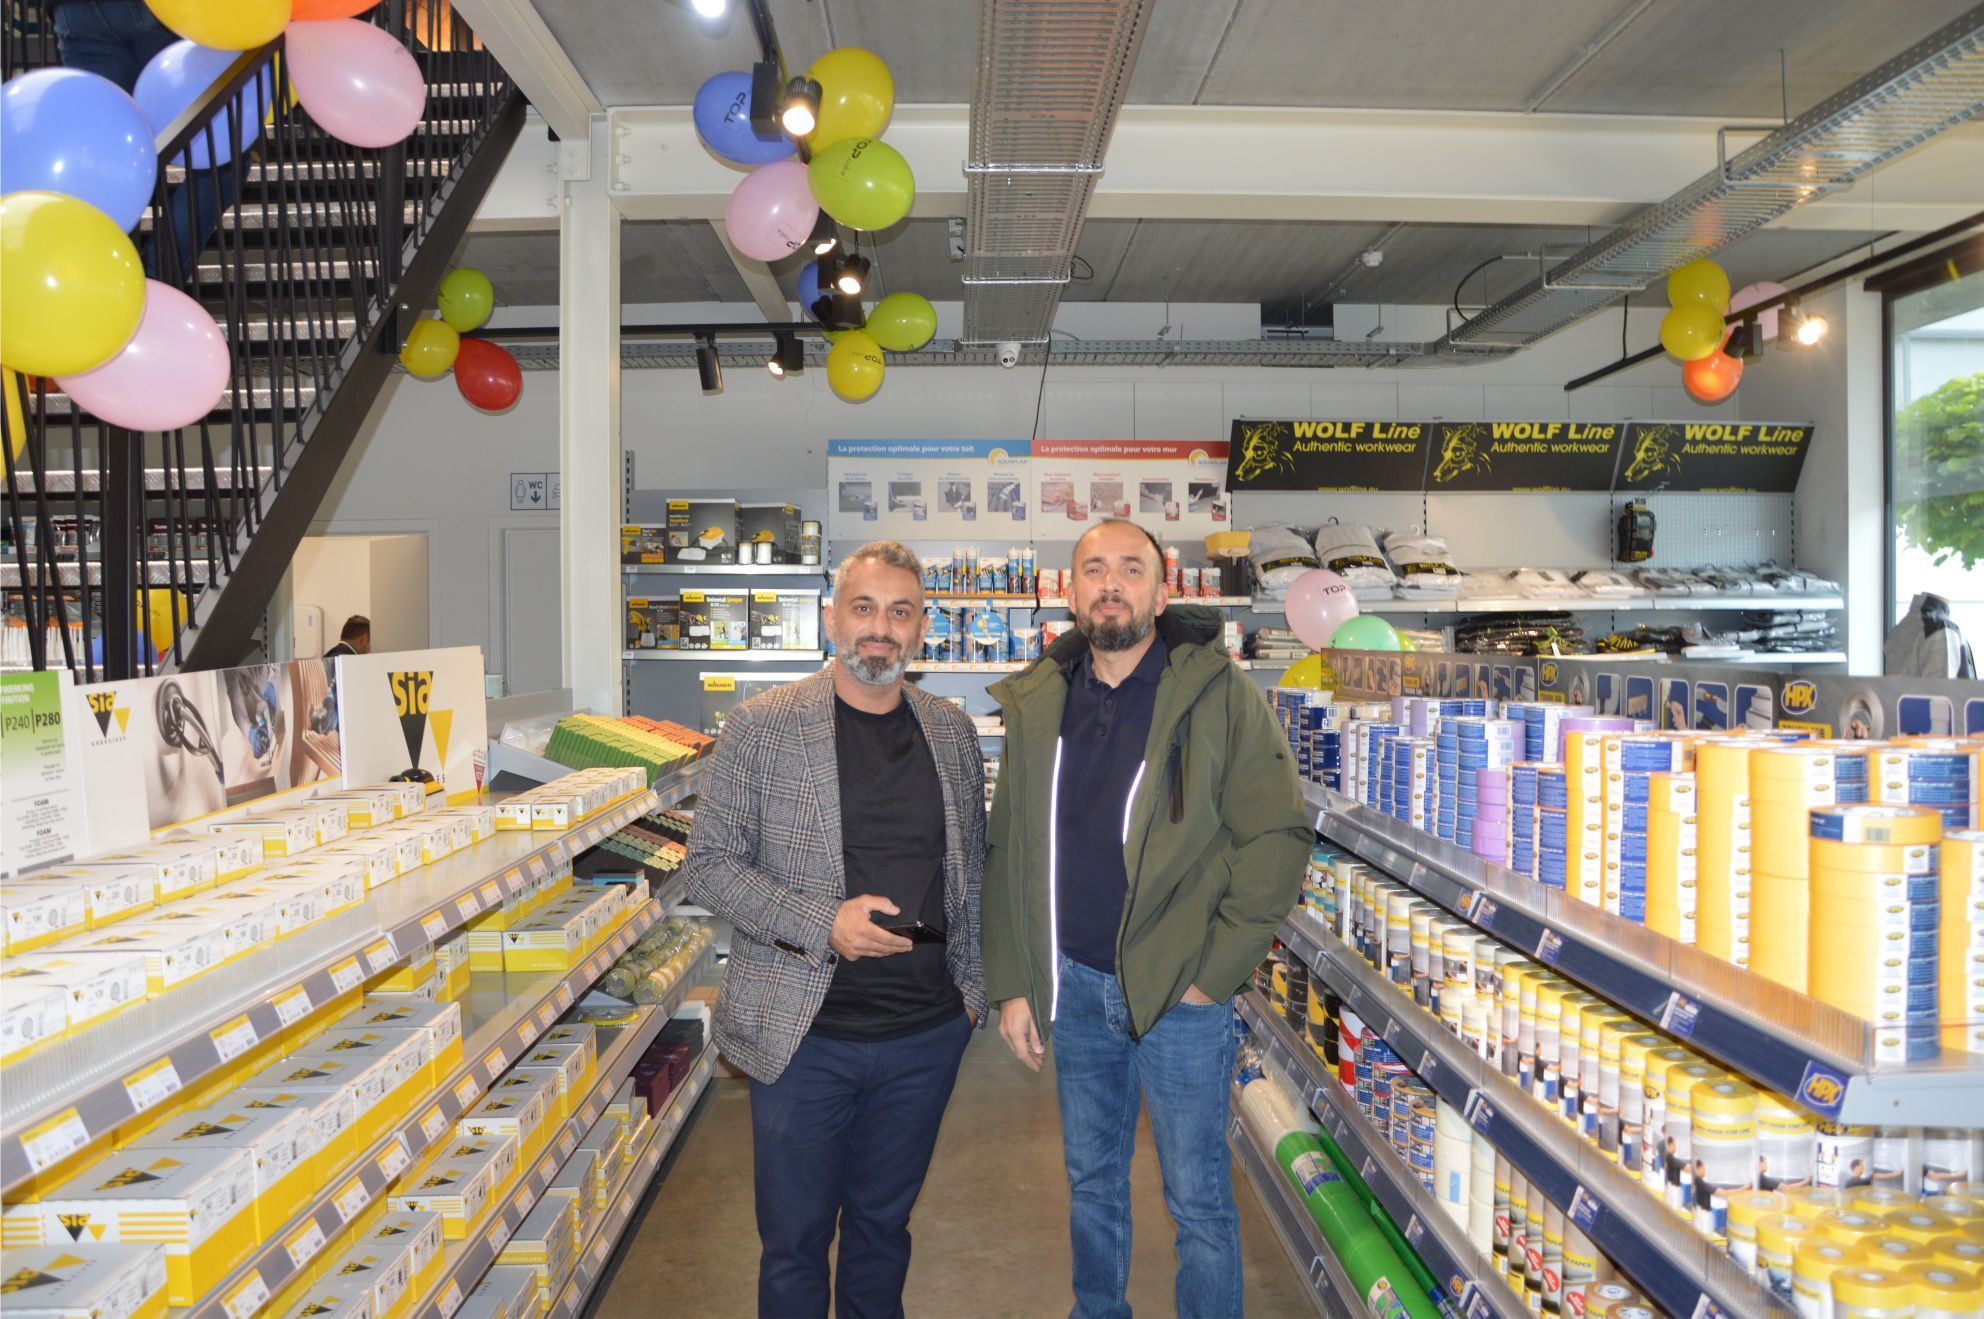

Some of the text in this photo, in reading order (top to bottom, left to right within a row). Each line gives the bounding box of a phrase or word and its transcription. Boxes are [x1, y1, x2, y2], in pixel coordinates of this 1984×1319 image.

[723, 91, 747, 125] TOP
[1292, 421, 1421, 440] WOLF Line
[1491, 422, 1615, 440] WOLF Line
[1684, 424, 1805, 443] WOLF Line
[848, 445, 887, 454] protection
[888, 445, 920, 454] optimale
[962, 444, 974, 452] toit
[1050, 446, 1088, 454] protection
[1090, 446, 1122, 454] optimale
[1292, 440, 1416, 453] Authentic workwear
[1490, 442, 1610, 454] Authentic workwear
[1682, 442, 1798, 456] Authentic workwear
[528, 480, 543, 490] WC
[1322, 584, 1346, 596] TOP
[0, 682, 34, 694] WERKING
[387, 671, 432, 718] sia
[88, 691, 116, 713] sia
[1785, 684, 1816, 709] HPX
[6, 711, 60, 731] P240 P280
[34, 798, 50, 808] FOAM
[1806, 1072, 1842, 1106] HPX
[58, 1213, 91, 1227] sia
[1570, 1258, 1592, 1268] PAPER
